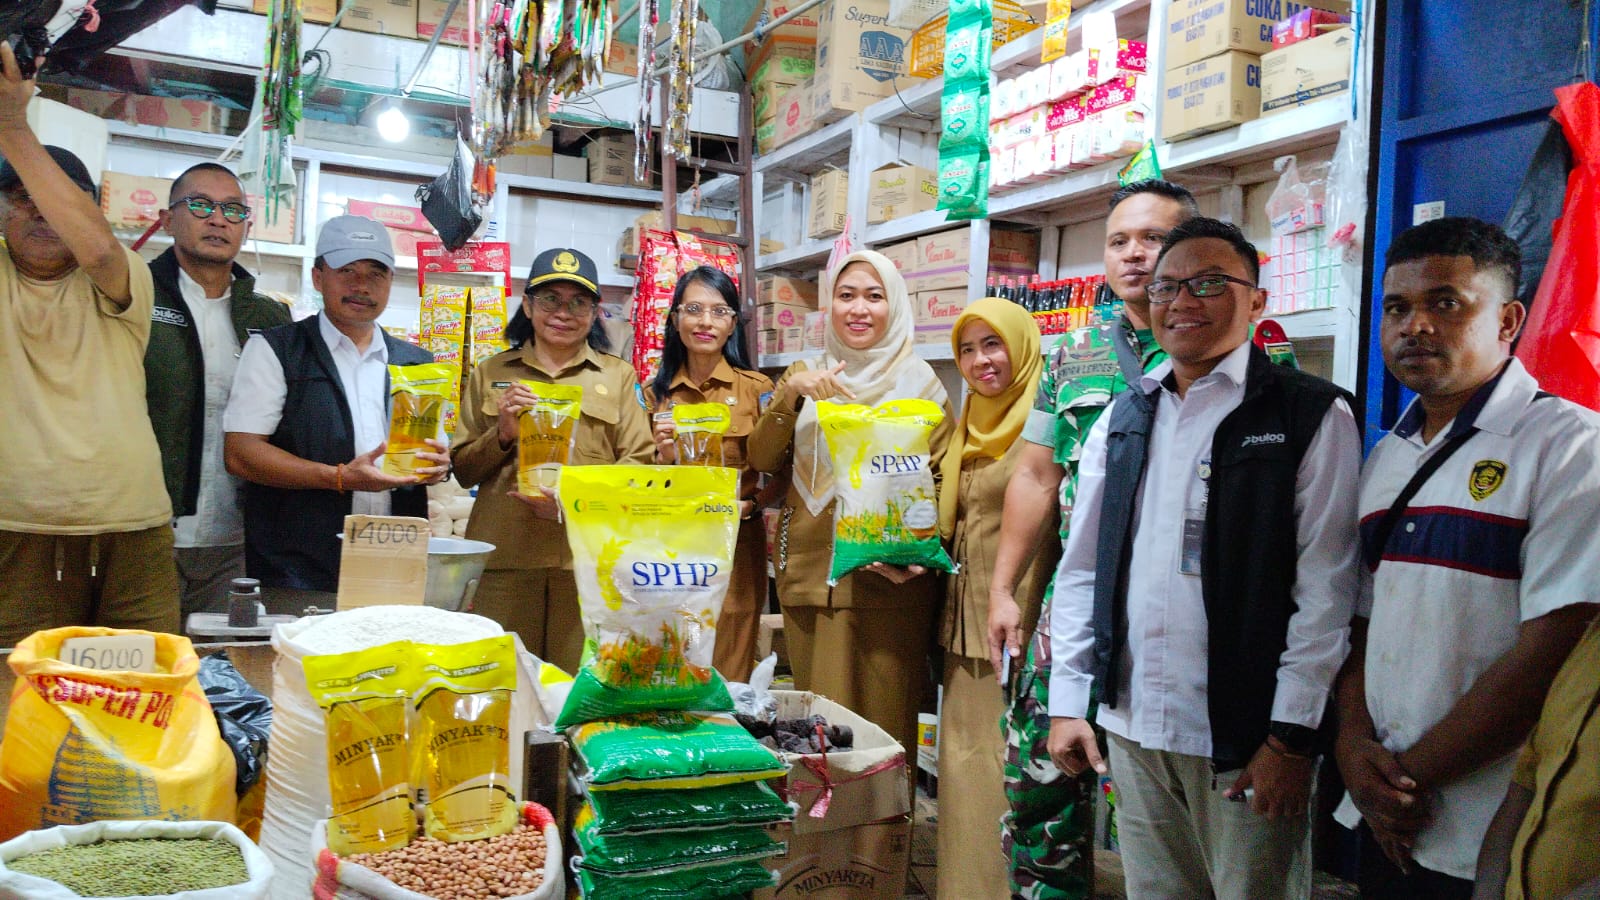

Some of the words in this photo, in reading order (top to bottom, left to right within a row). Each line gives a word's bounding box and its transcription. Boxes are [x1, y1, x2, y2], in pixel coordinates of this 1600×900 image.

[860, 36, 904, 63] AAA
[153, 308, 184, 323] bulog
[1252, 432, 1285, 443] bulog
[870, 454, 921, 474] SPHP
[704, 503, 733, 514] bulog
[350, 521, 418, 544] 14000
[632, 561, 718, 587] SPHP
[70, 647, 144, 670] 16000
